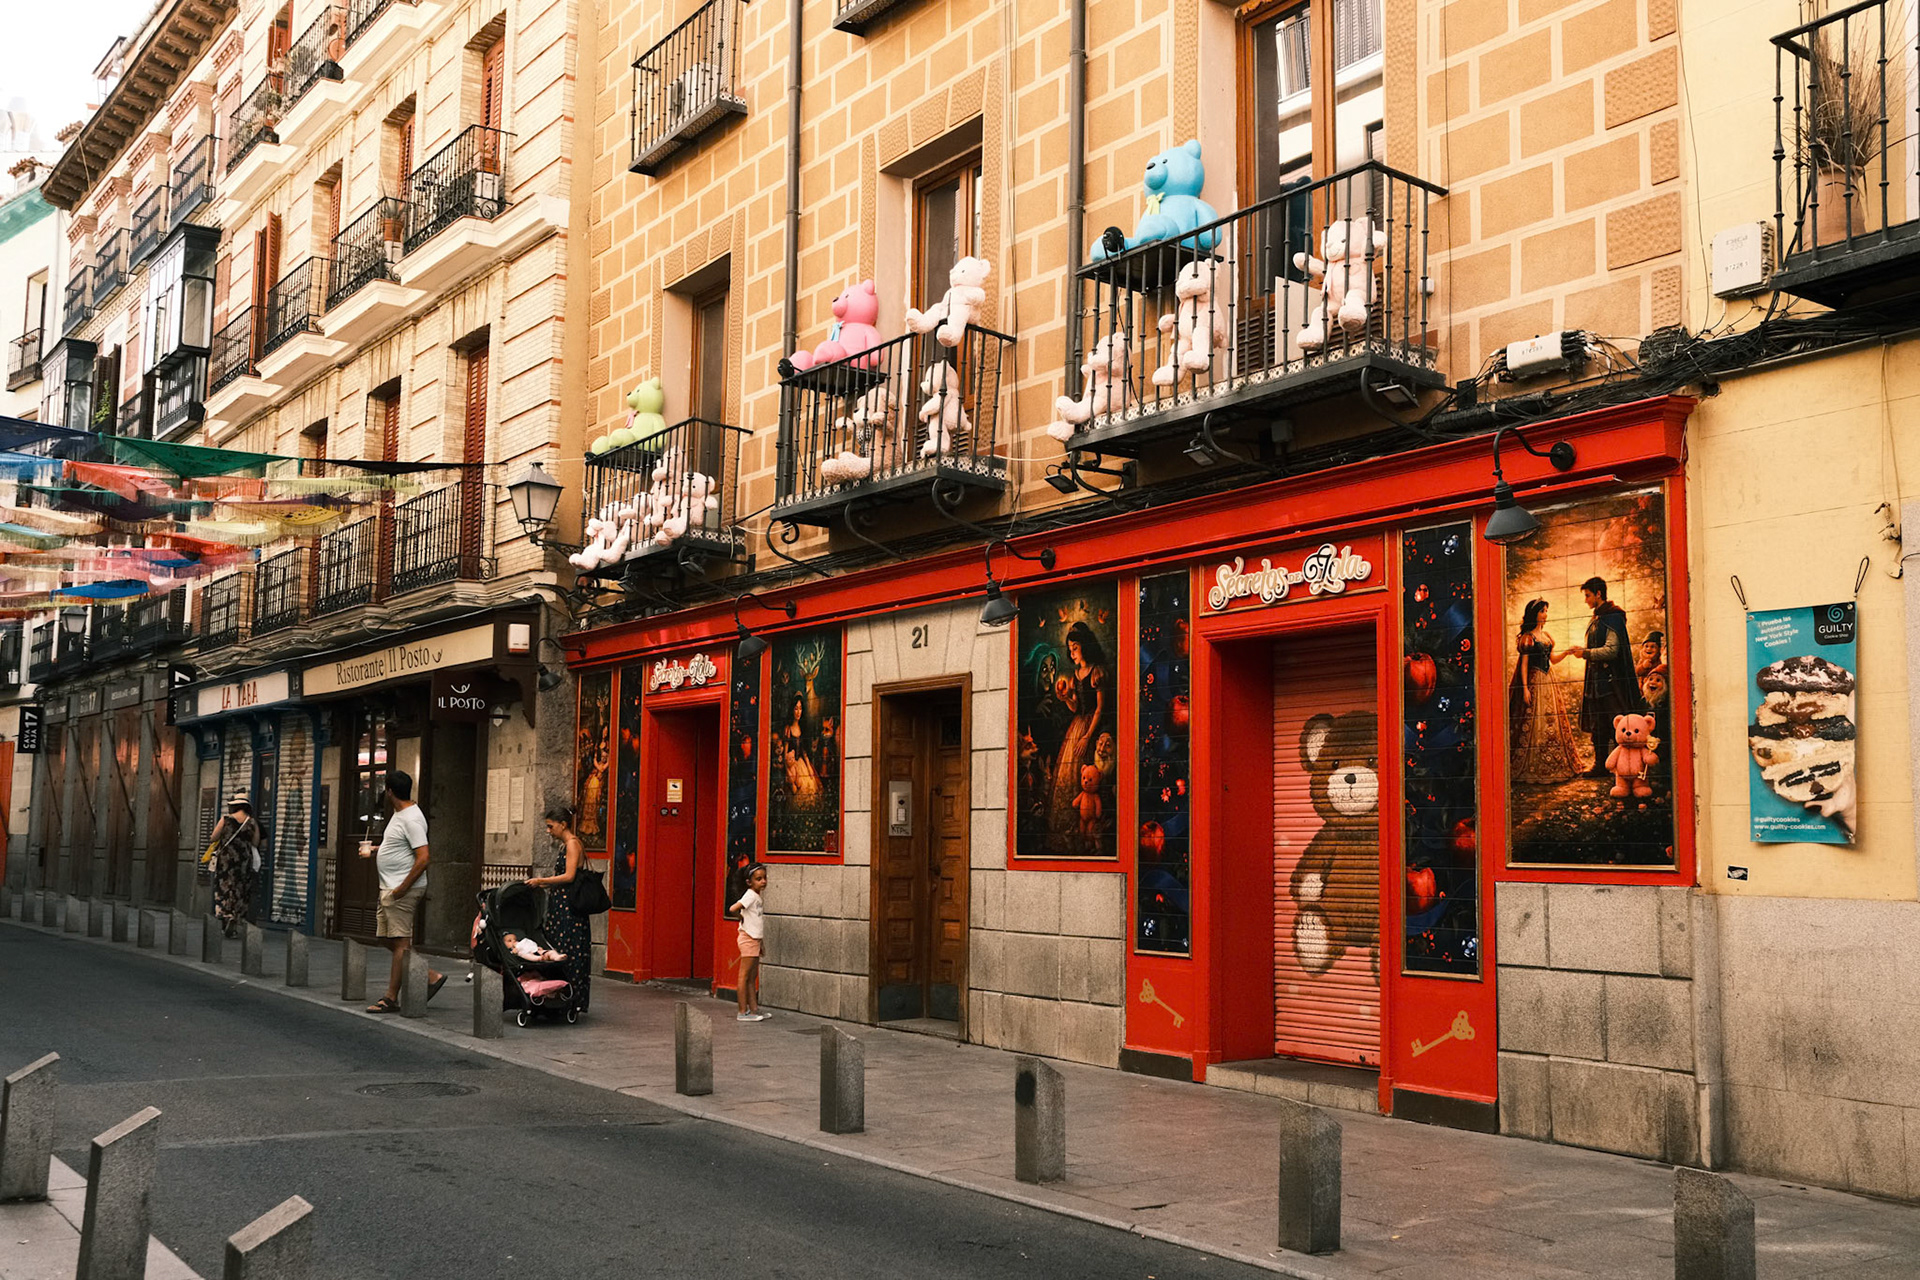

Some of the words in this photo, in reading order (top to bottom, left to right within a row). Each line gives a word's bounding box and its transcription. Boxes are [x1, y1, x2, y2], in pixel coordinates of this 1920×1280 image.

[1208, 556, 1289, 610] Secretos
[912, 624, 928, 649] 21
[1818, 623, 1854, 634] GUILTY
[1764, 638, 1787, 648] Cookies
[336, 657, 385, 686] Ristorante
[387, 648, 397, 673] Il
[399, 646, 430, 671] Posto
[221, 686, 232, 709] LA
[236, 681, 259, 707] TABA
[438, 696, 447, 709] IL
[450, 697, 486, 710] POSTO
[24, 711, 38, 728] 17
[22, 729, 30, 749] CAVA
